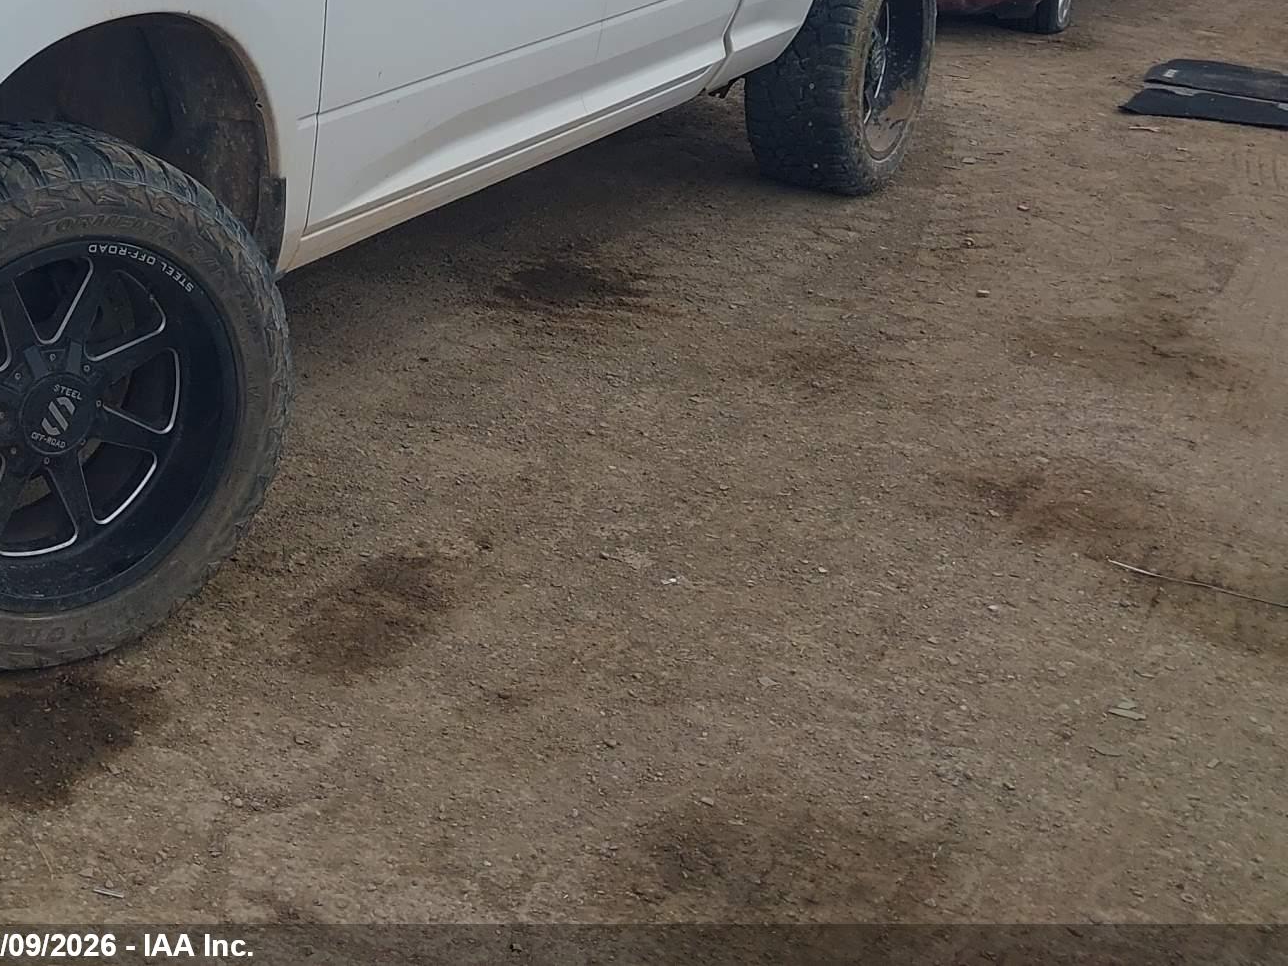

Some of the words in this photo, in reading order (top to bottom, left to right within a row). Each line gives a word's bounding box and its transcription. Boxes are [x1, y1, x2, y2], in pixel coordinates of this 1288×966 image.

[88, 244, 157, 265] OFF-ROAD
[160, 262, 195, 293] STEEL
[53, 384, 83, 401] STEEL
[31, 431, 66, 449] OFF-ROAD
